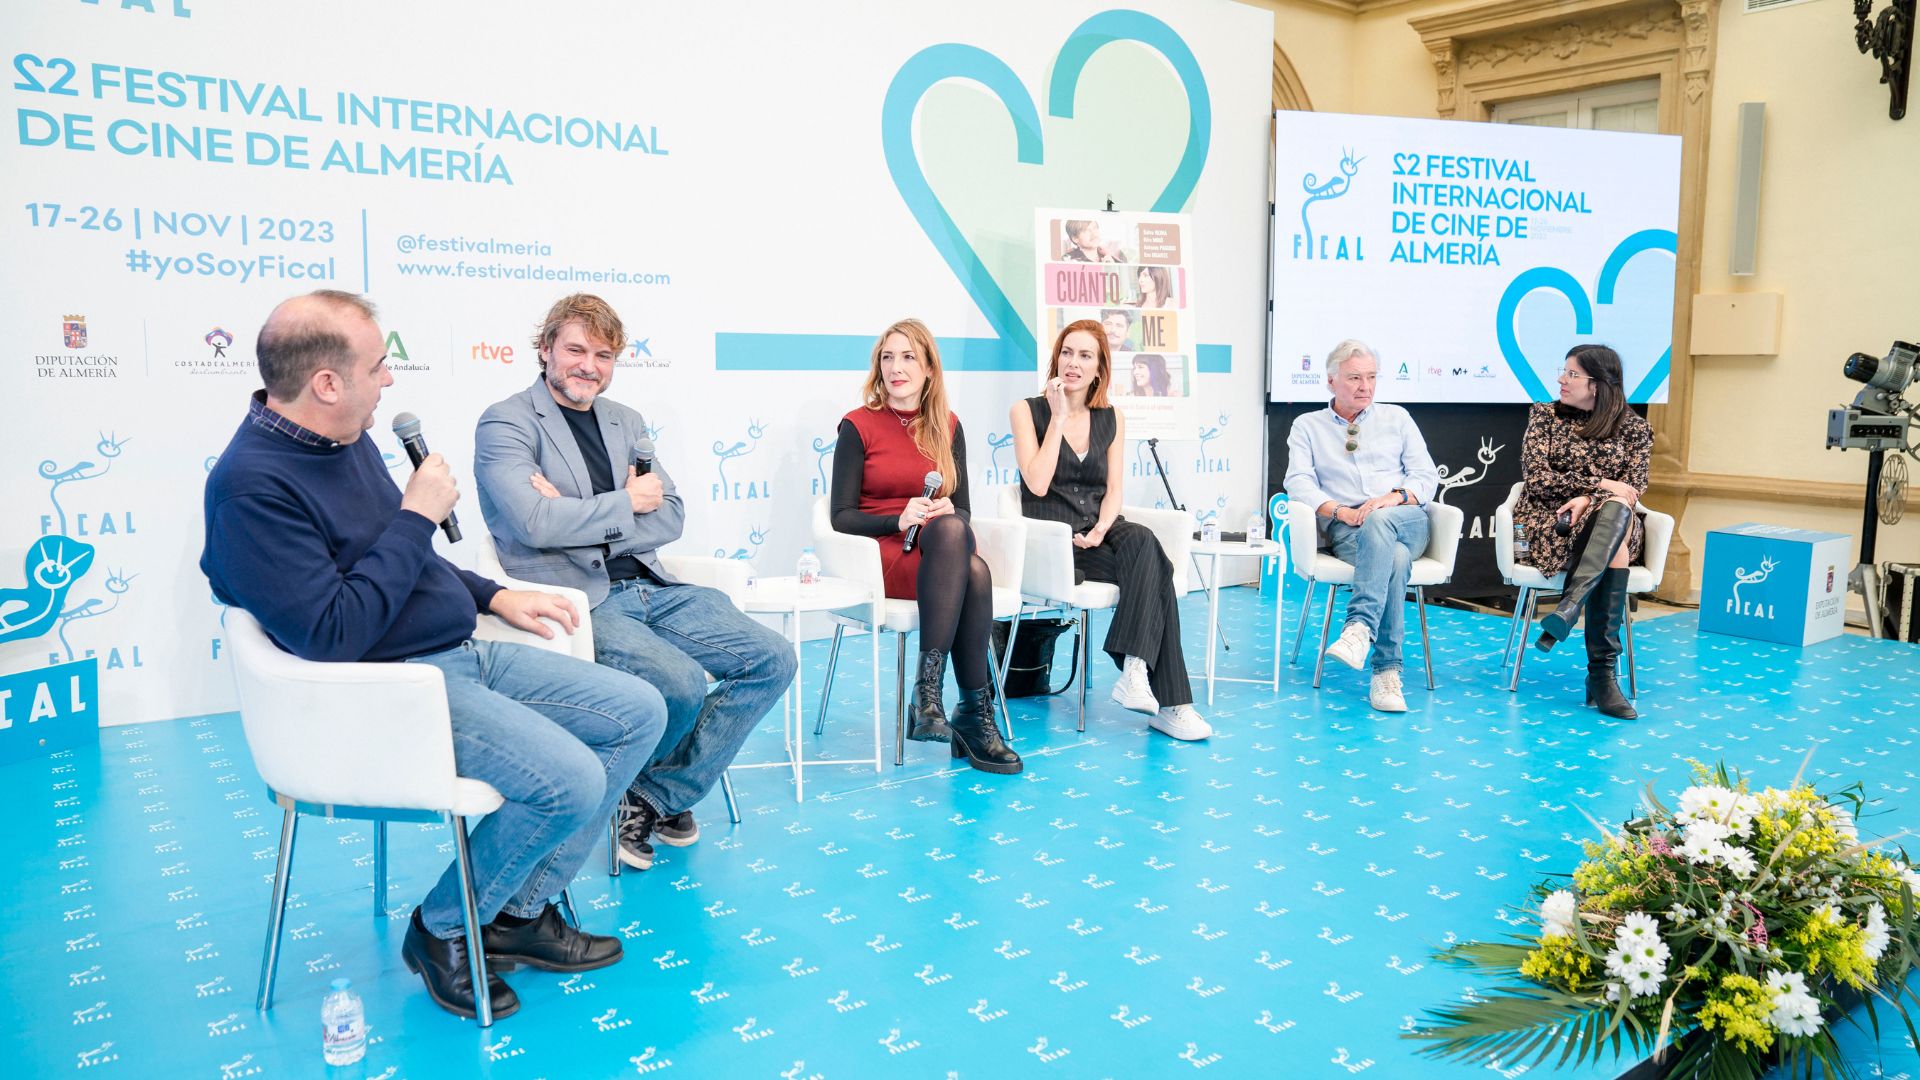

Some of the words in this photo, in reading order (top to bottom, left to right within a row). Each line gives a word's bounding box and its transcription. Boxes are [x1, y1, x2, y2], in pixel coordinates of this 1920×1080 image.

[92, 63, 322, 122] FESTIVAL
[337, 92, 669, 155] INTERNACIONAL
[17, 108, 95, 151] DE
[107, 119, 234, 163] CINE
[246, 131, 309, 169] DE
[320, 140, 514, 185] ALMERÍA
[1426, 155, 1536, 182] FESTIVAL
[1392, 182, 1592, 214] INTERNACIONAL
[25, 203, 123, 232] 17-26
[153, 210, 231, 237] NOV
[259, 217, 335, 243] 2023
[1392, 211, 1425, 235] DE
[1431, 213, 1490, 237] CINE
[1496, 216, 1528, 239] DE
[397, 234, 552, 257] @festivalmeria
[1293, 234, 1364, 261] FICAL
[1390, 233, 1500, 266] ALMERÍA
[126, 249, 335, 283] #yoSoyFical
[397, 261, 670, 285] www.festivaldealmeria.com
[1056, 265, 1120, 304] CUÁNTO
[1142, 315, 1165, 347] ME
[35, 353, 118, 366] DIPUTACIÓN
[472, 342, 513, 363] rtve
[38, 368, 57, 378] DE
[60, 366, 117, 378] ALMERÍA
[987, 468, 1021, 485] FICA
[1196, 458, 1231, 473] FICAL
[712, 480, 770, 501] FICAL
[40, 511, 136, 536] FICAL
[1726, 598, 1775, 620] FICAL
